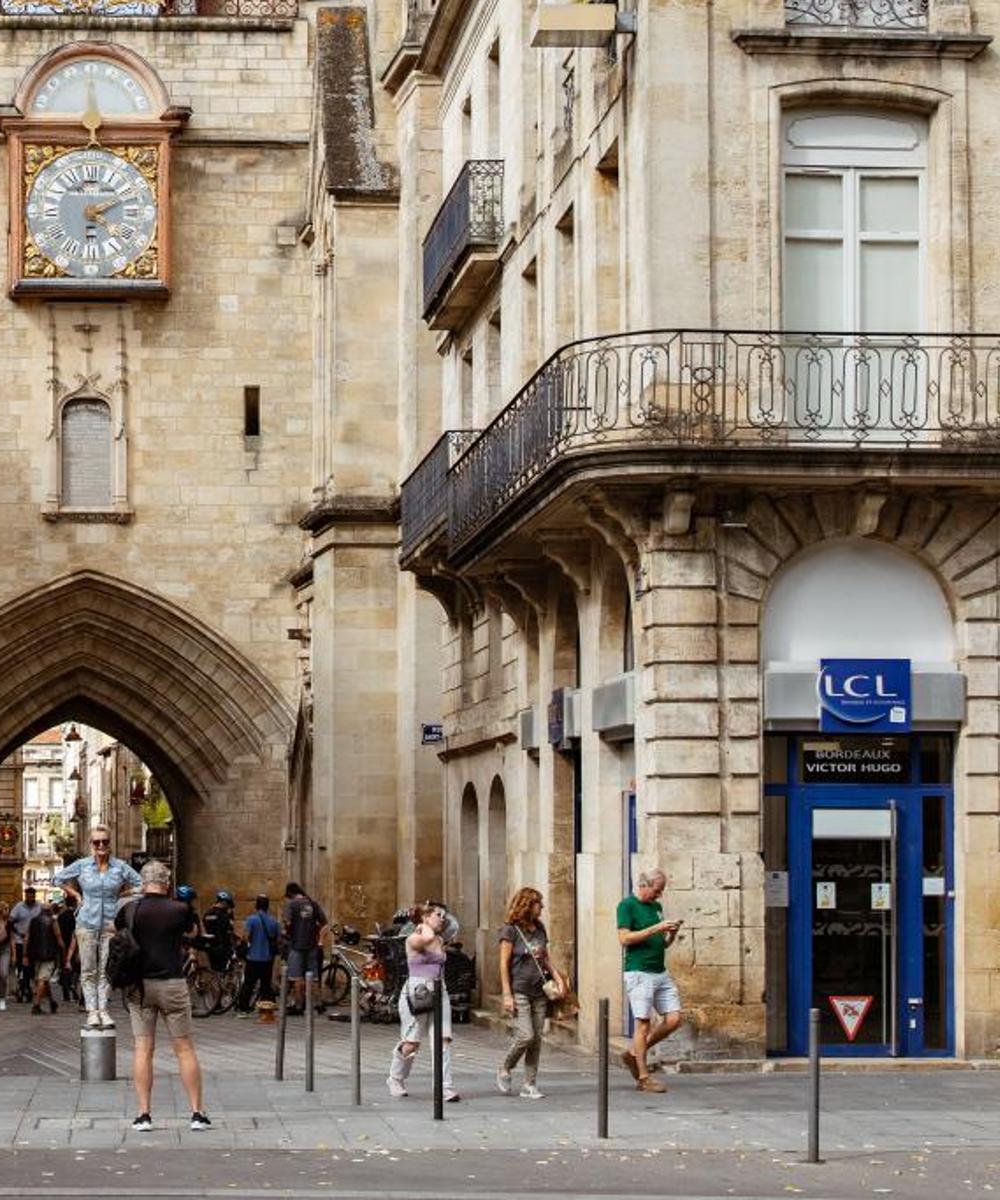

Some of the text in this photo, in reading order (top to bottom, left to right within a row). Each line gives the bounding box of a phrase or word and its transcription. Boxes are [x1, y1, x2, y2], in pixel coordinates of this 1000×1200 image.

[825, 674, 898, 698] LCL
[815, 749, 891, 760] BORDEAUX
[805, 763, 902, 773] VICTOR HUGO
